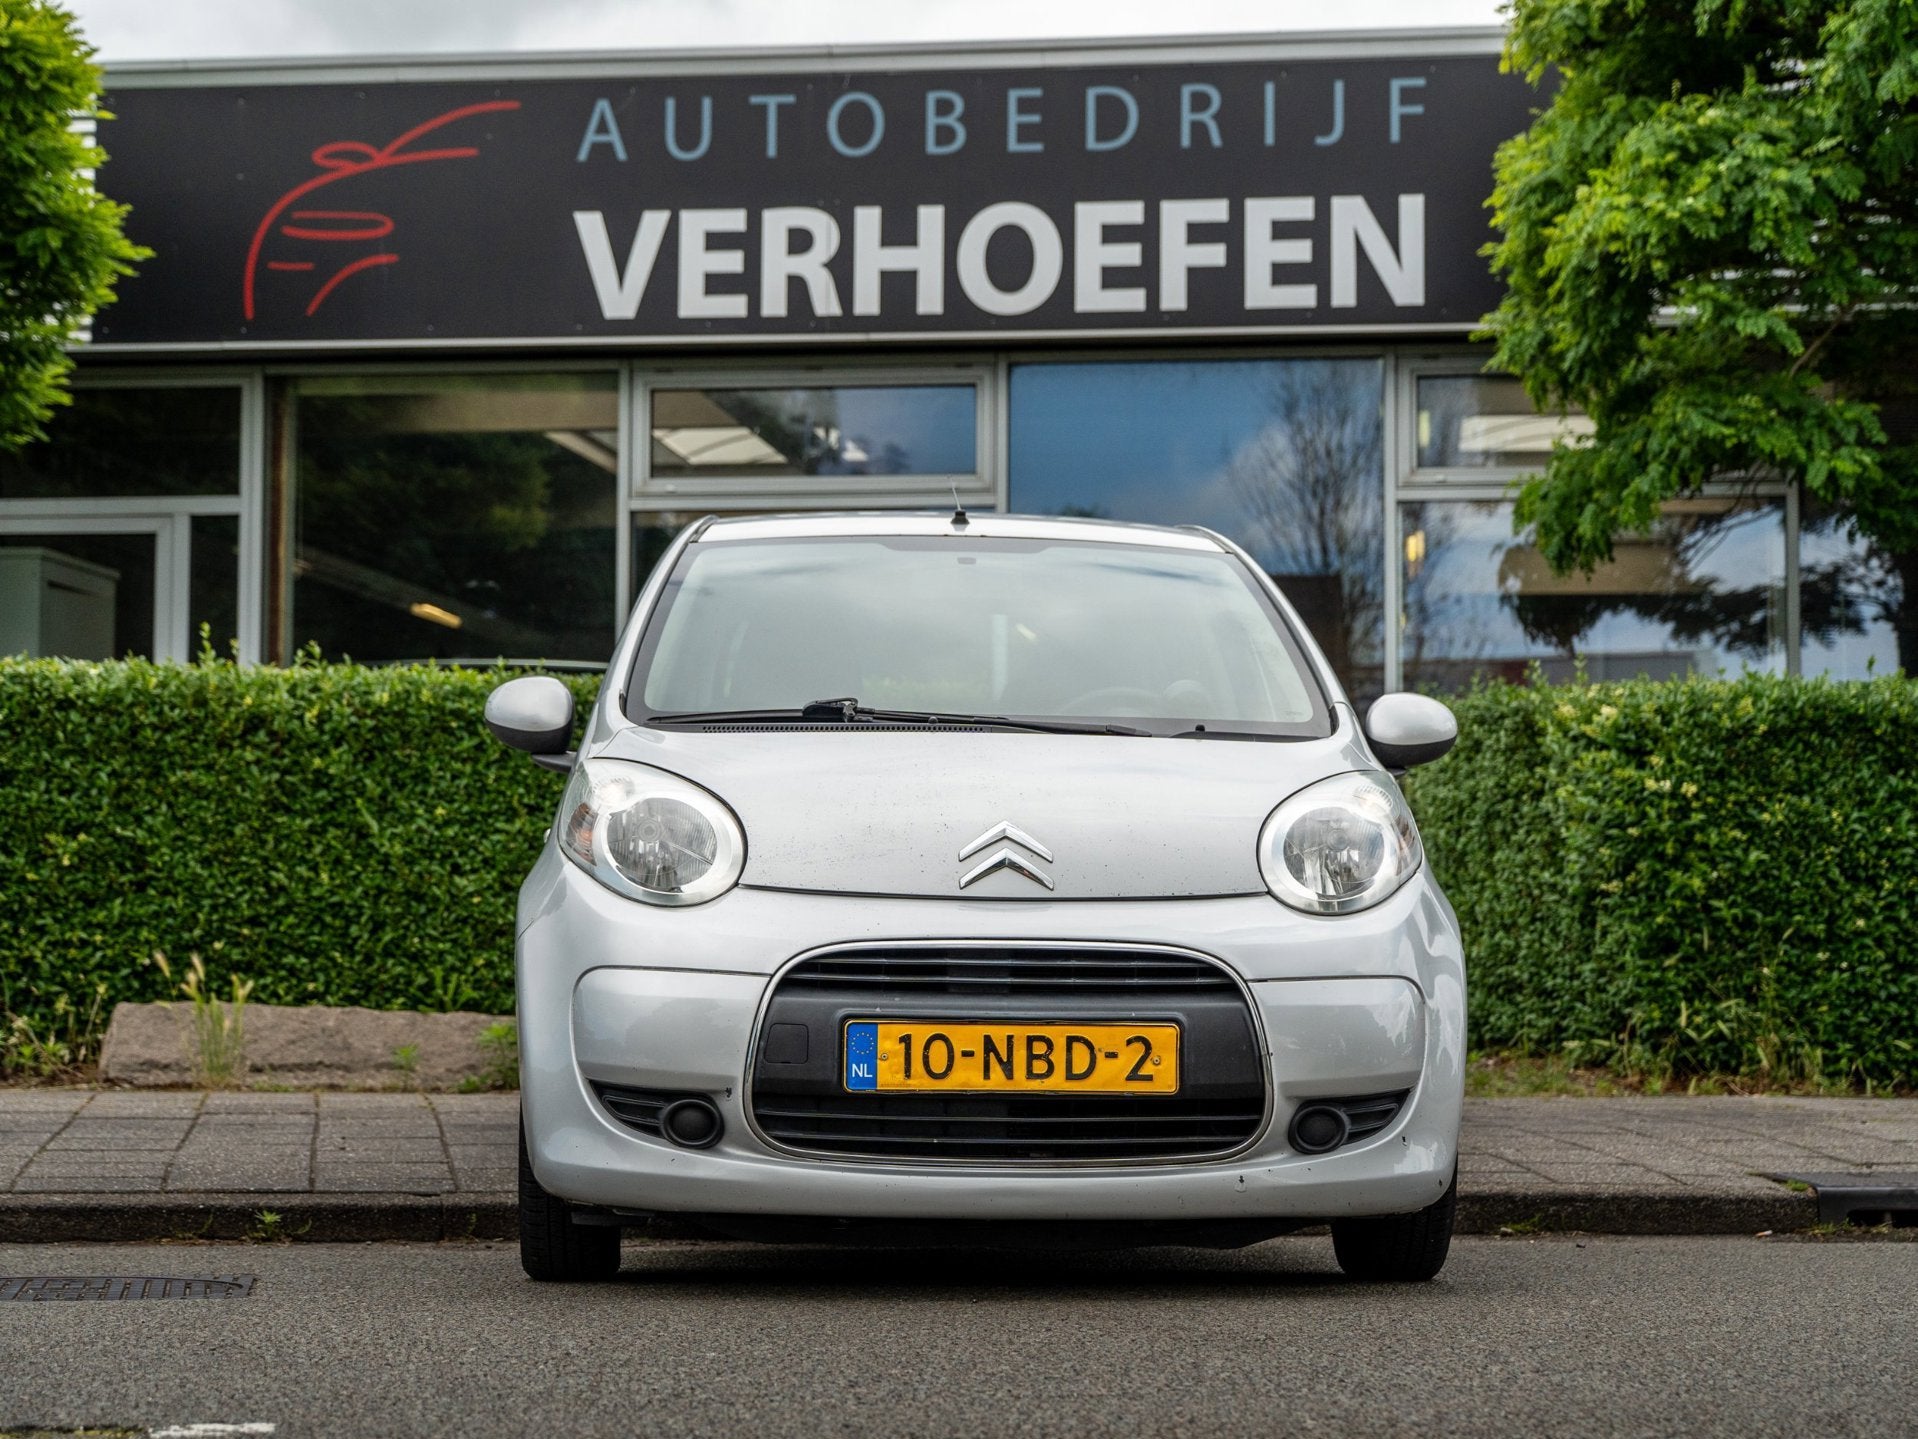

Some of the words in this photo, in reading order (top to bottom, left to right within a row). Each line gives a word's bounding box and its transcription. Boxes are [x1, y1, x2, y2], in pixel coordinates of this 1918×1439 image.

[576, 77, 1428, 163] AUTOBEDRIJF
[573, 193, 1427, 321] VERHOEFEN
[852, 1063, 873, 1078] NL
[898, 1033, 1155, 1082] 10-NBD-2
